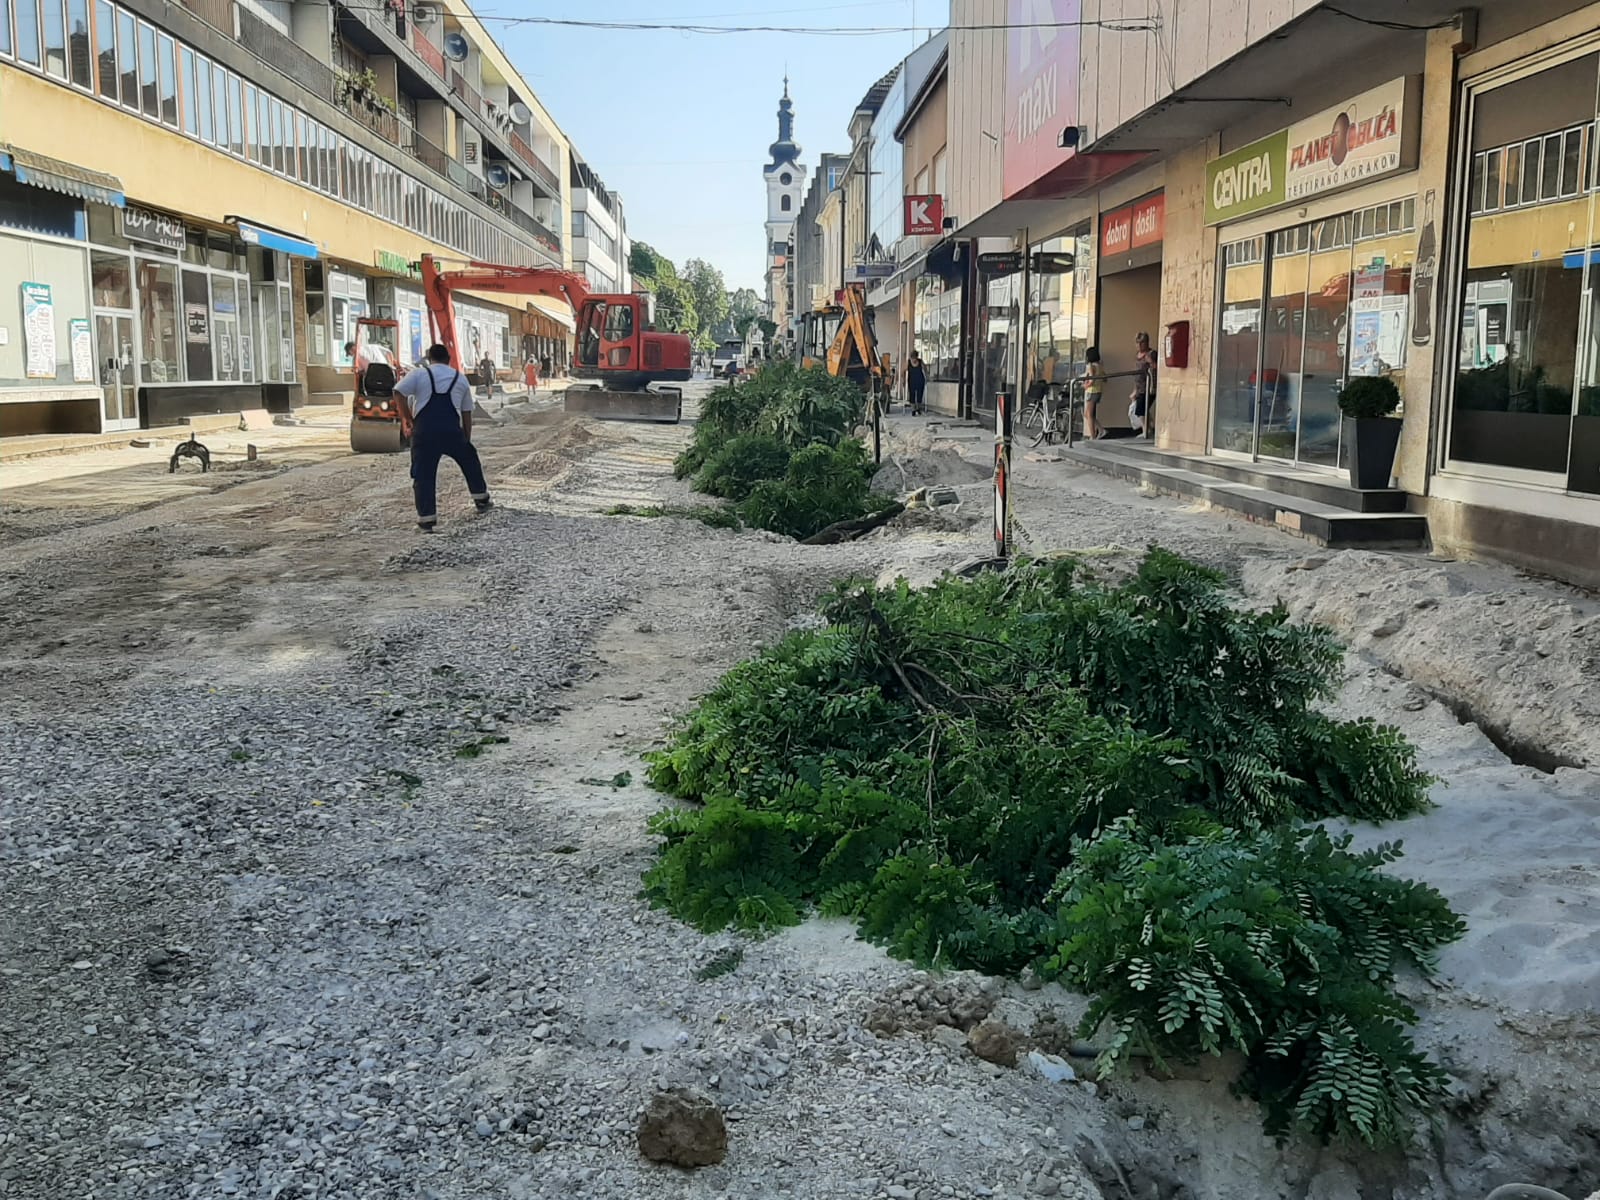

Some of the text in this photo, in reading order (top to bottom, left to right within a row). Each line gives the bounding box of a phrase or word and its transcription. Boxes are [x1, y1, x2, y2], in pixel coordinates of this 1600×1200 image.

[1018, 61, 1057, 144] maxi
[1289, 131, 1339, 173] PLANET
[1213, 151, 1272, 210] CENTRA
[1288, 153, 1397, 198] TESTIRANO KORAKOM
[911, 200, 933, 225] K
[1106, 205, 1156, 247] dobro došli
